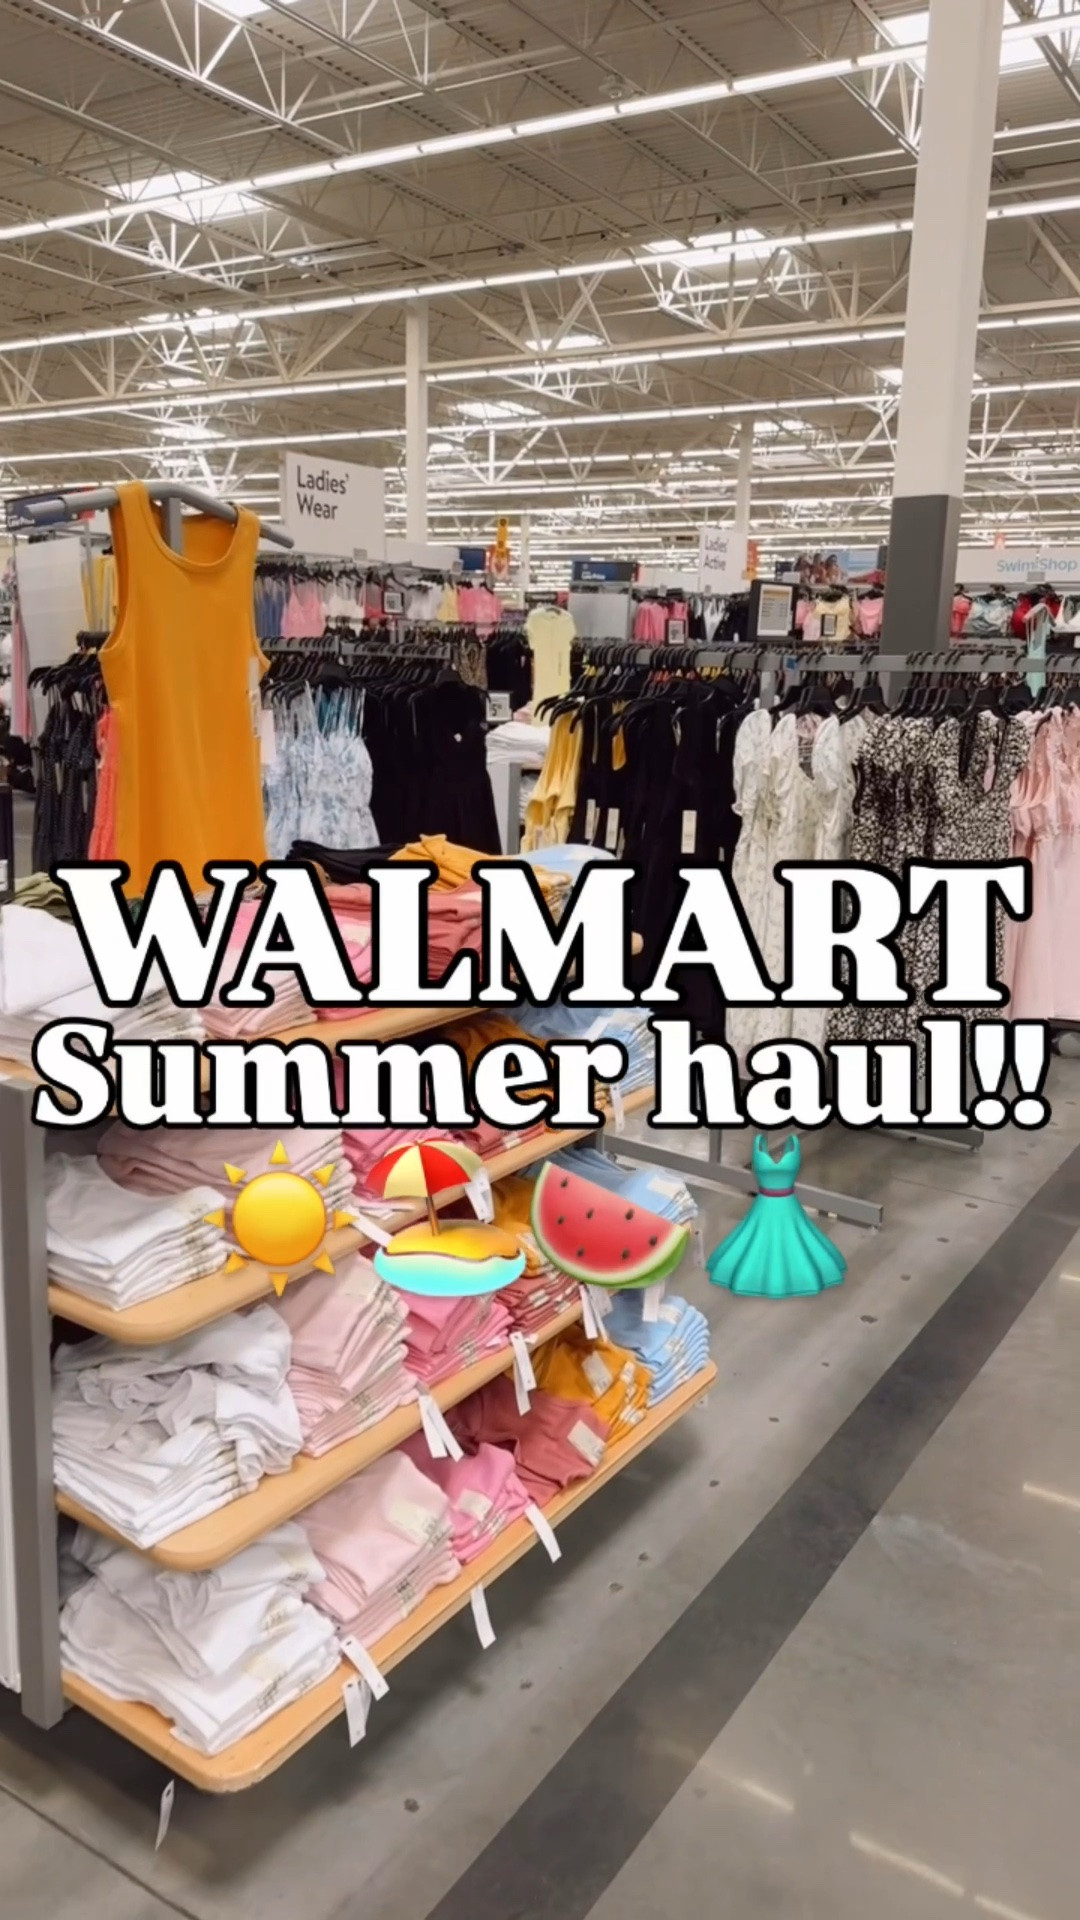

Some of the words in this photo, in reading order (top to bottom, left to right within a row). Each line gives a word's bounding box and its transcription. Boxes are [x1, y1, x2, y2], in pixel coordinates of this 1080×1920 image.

[296, 464, 350, 495] Ladies'
[296, 491, 338, 520] Wear
[996, 558, 1036, 573] Swim
[1039, 557, 1079, 573] Shop
